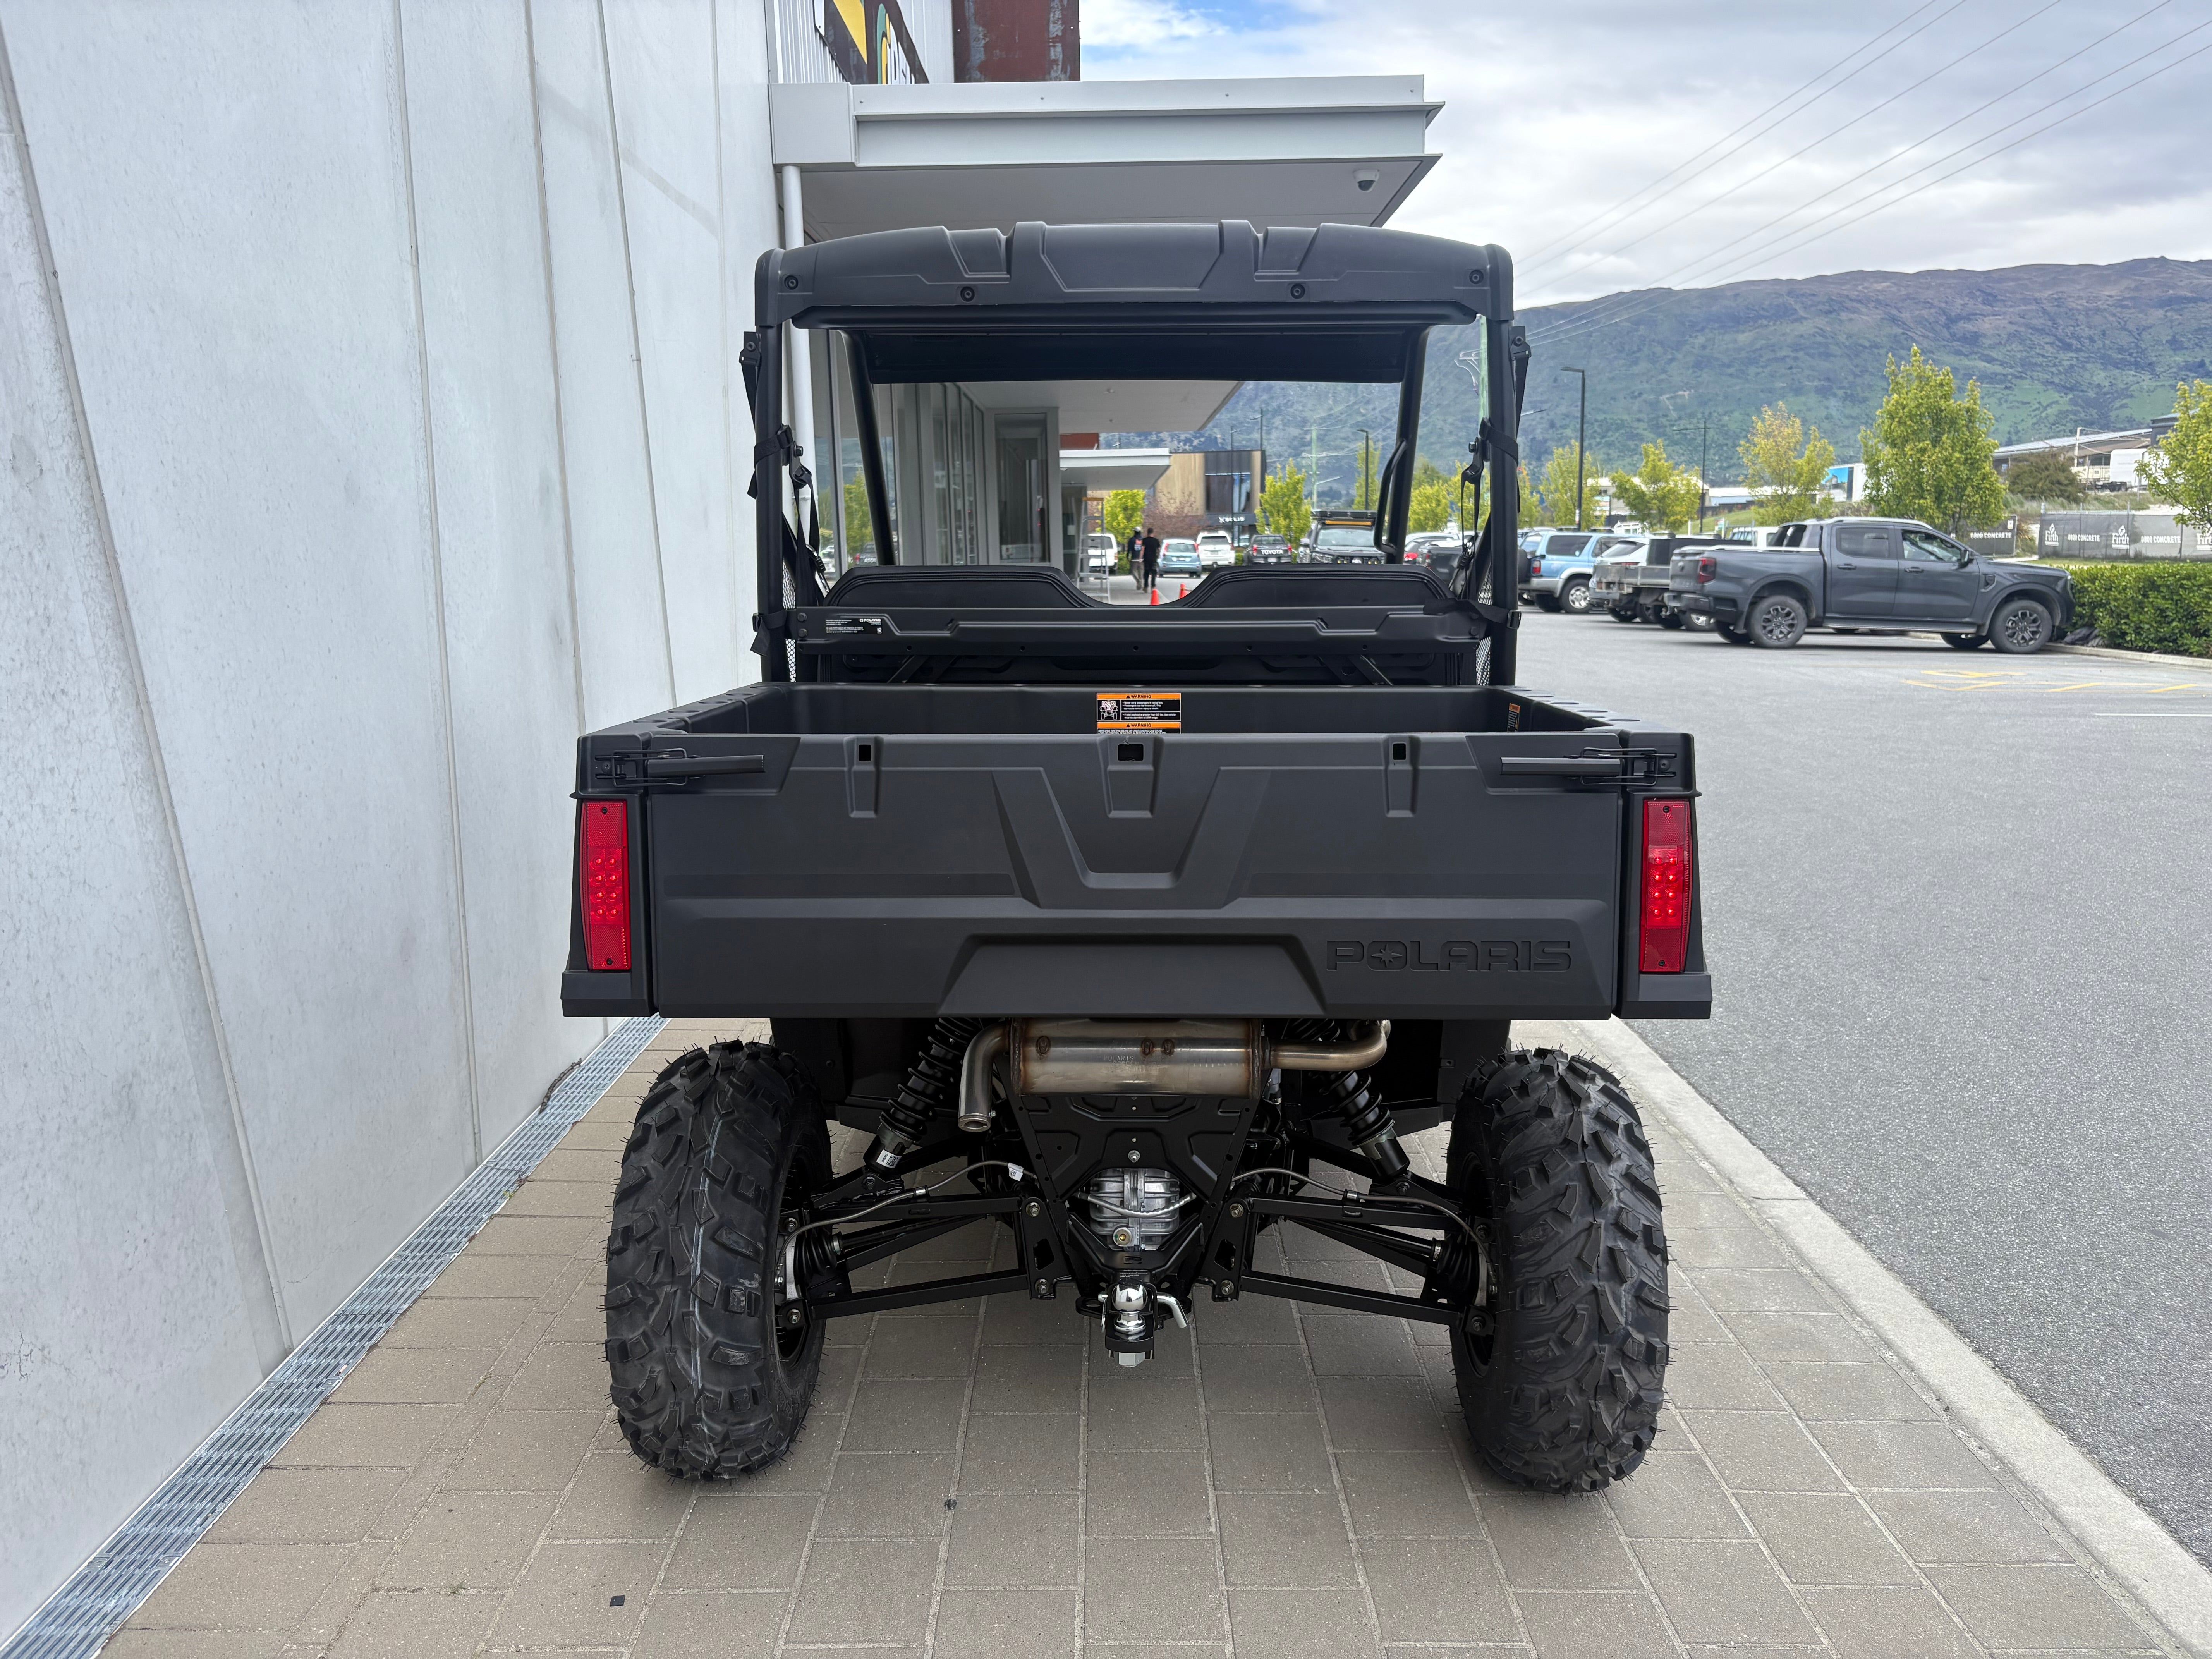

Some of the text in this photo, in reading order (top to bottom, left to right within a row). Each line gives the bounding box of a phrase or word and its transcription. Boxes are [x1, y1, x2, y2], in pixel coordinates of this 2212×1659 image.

[2045, 530, 2059, 541] Firth
[2112, 532, 2129, 544] Firth
[2196, 533, 2212, 544] Firt
[1326, 940, 1571, 972] POLARIS
